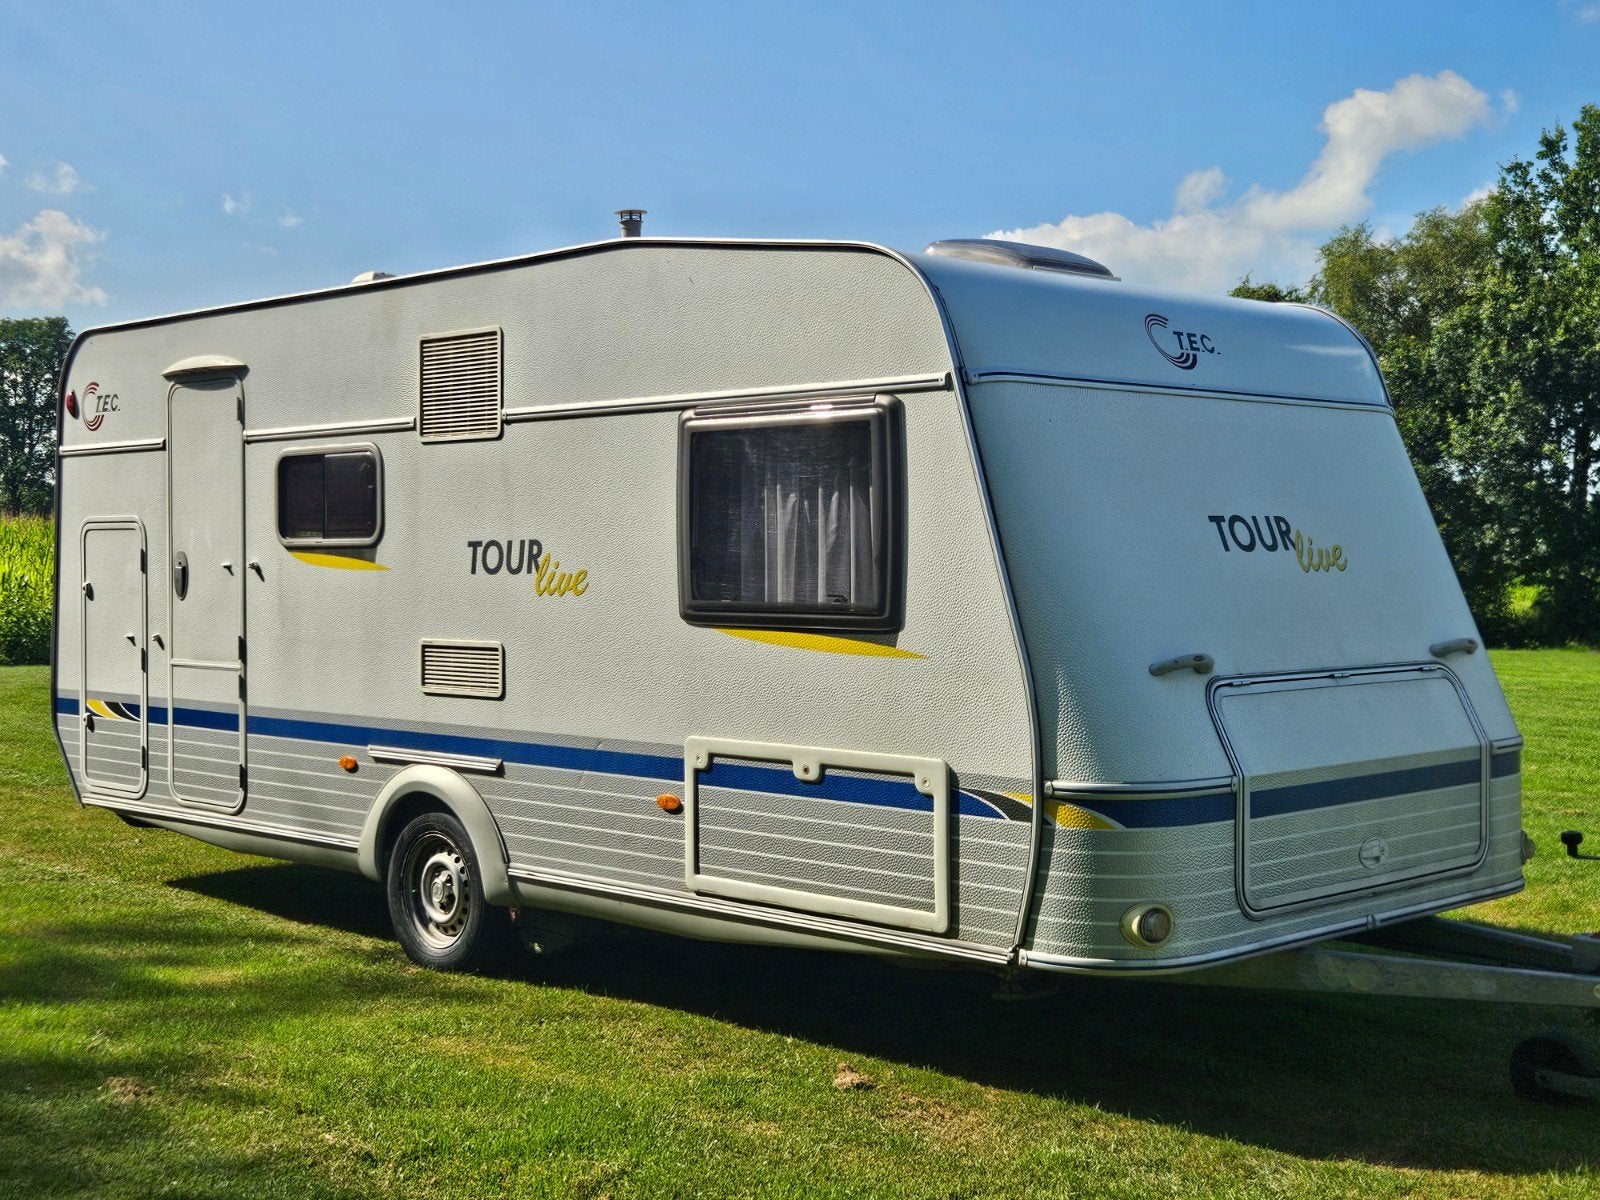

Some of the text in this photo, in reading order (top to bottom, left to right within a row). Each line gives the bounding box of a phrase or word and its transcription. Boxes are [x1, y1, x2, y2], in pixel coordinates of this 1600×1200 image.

[467, 539, 589, 597] TOUR live
[1207, 514, 1348, 573] TOUR live
